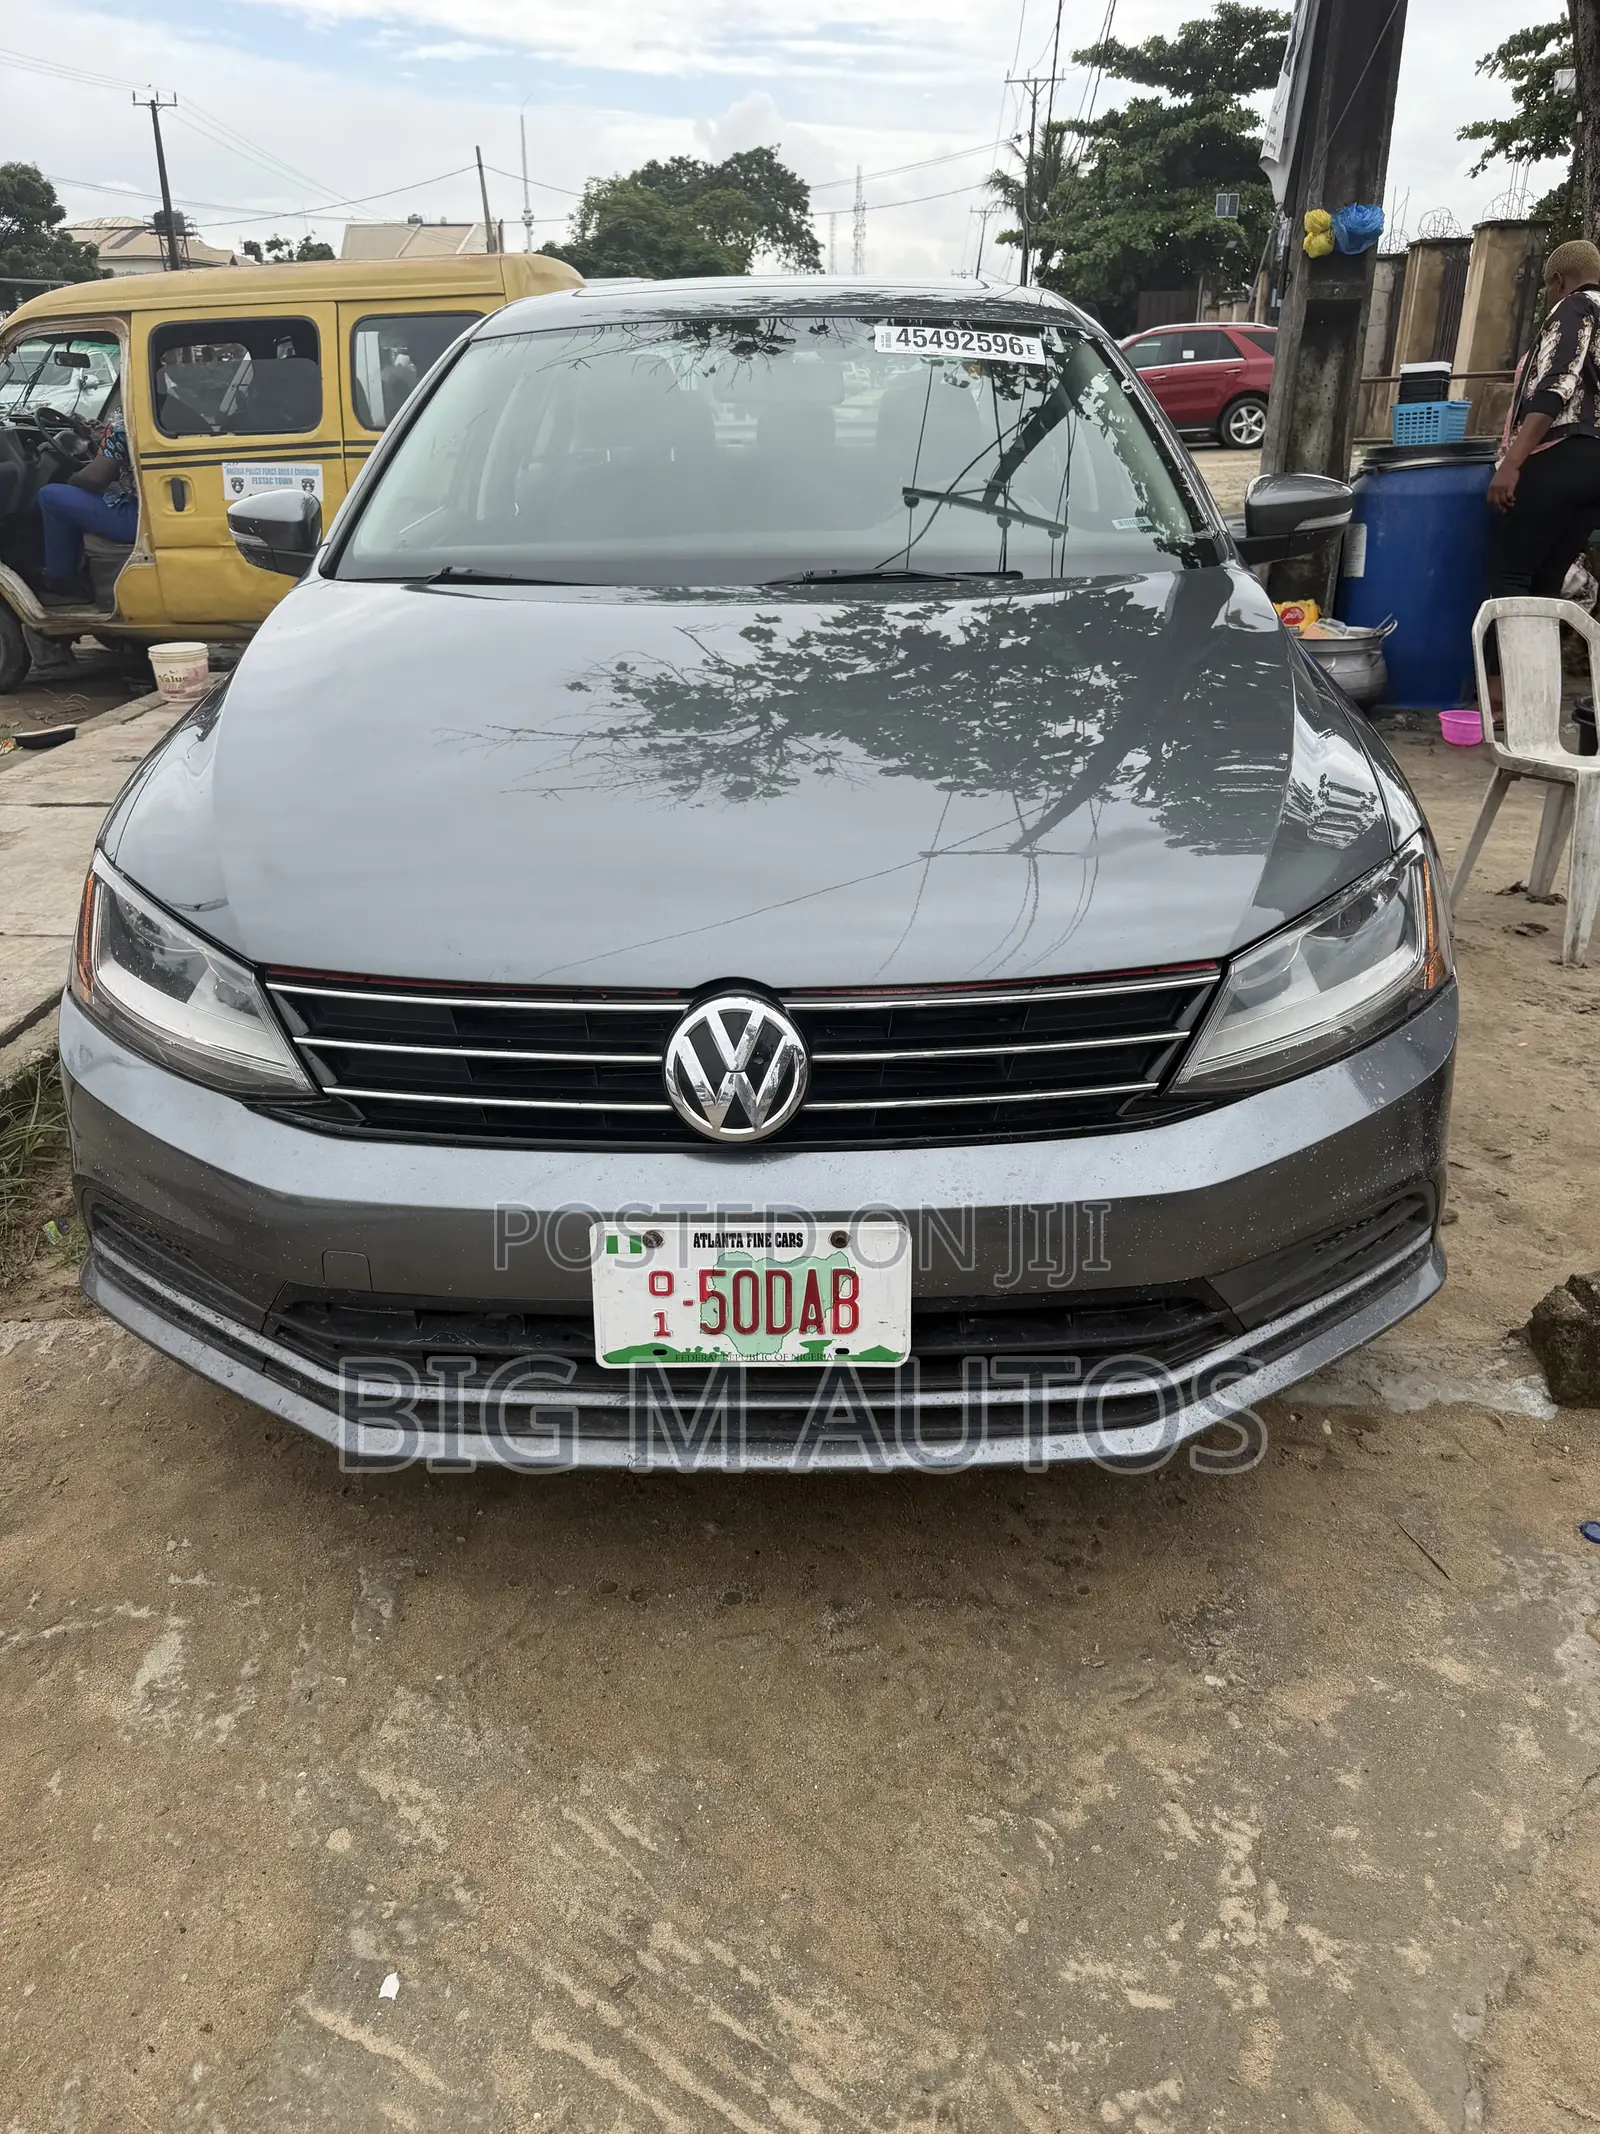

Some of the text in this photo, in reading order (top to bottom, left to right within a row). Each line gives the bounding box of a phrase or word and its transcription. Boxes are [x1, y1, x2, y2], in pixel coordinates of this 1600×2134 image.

[245, 467, 261, 476] POLICE
[262, 468, 277, 476] FORCE
[274, 477, 293, 485] TOWN
[693, 1231, 805, 1249] ATLANTA FINE CARS
[722, 1352, 771, 1362] REPUBLIC
[774, 1353, 789, 1362] OF
[791, 1352, 834, 1362] NIGERIA
